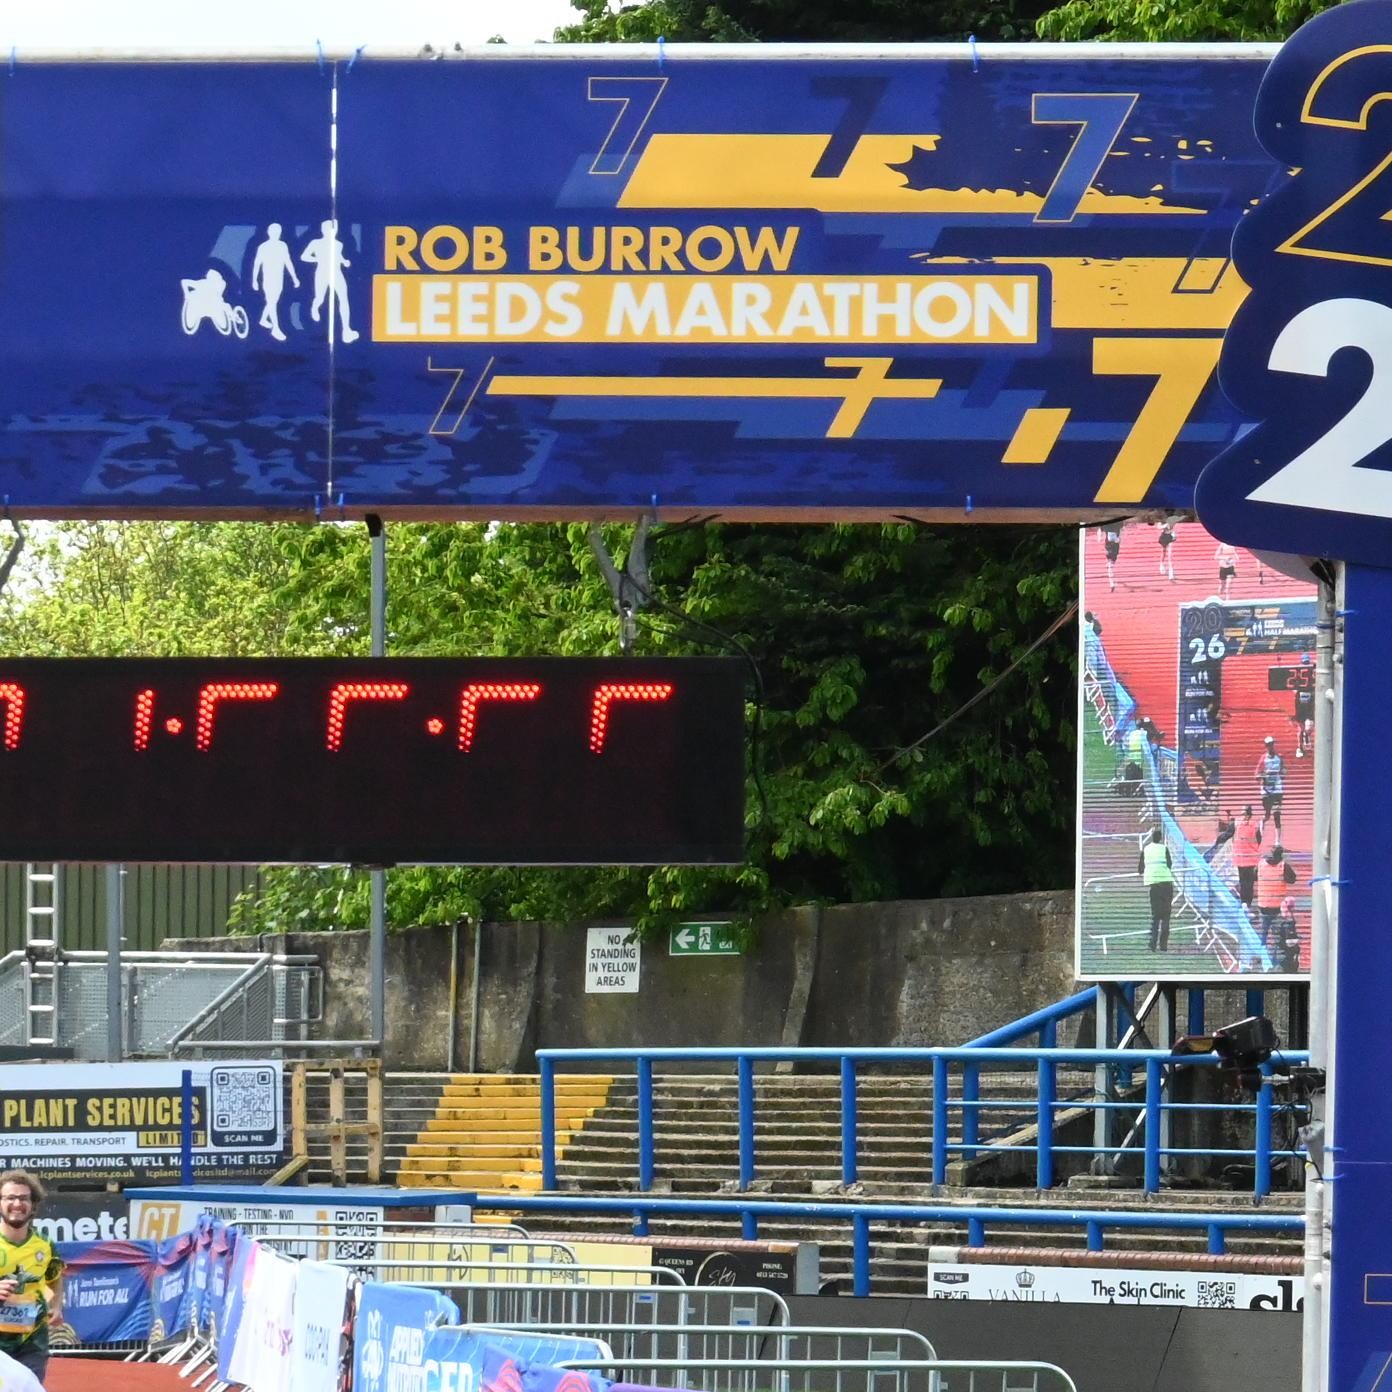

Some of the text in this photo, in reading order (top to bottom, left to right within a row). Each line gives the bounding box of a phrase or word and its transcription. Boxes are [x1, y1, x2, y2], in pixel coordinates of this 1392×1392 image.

[384, 225, 800, 272] ROB BURROW
[385, 281, 1029, 338] LEEDS MARATHON
[607, 935, 621, 945] NO
[590, 948, 637, 959] STANDING
[588, 962, 638, 973] IN YELLOW
[596, 975, 626, 986] AREAS
[4, 1098, 78, 1127] PLANT
[71, 1135, 127, 1146] TRANSPORT
[145, 1131, 200, 1145] LIMITD
[224, 1133, 264, 1143] SCAN ME
[11, 1157, 71, 1168] MACHINES
[76, 1156, 127, 1167] MOVING.
[131, 1156, 164, 1167] WE'LL
[223, 1155, 244, 1165] THE
[249, 1154, 277, 1165] REST
[1091, 1280, 1186, 1300] The Skin Clinic
